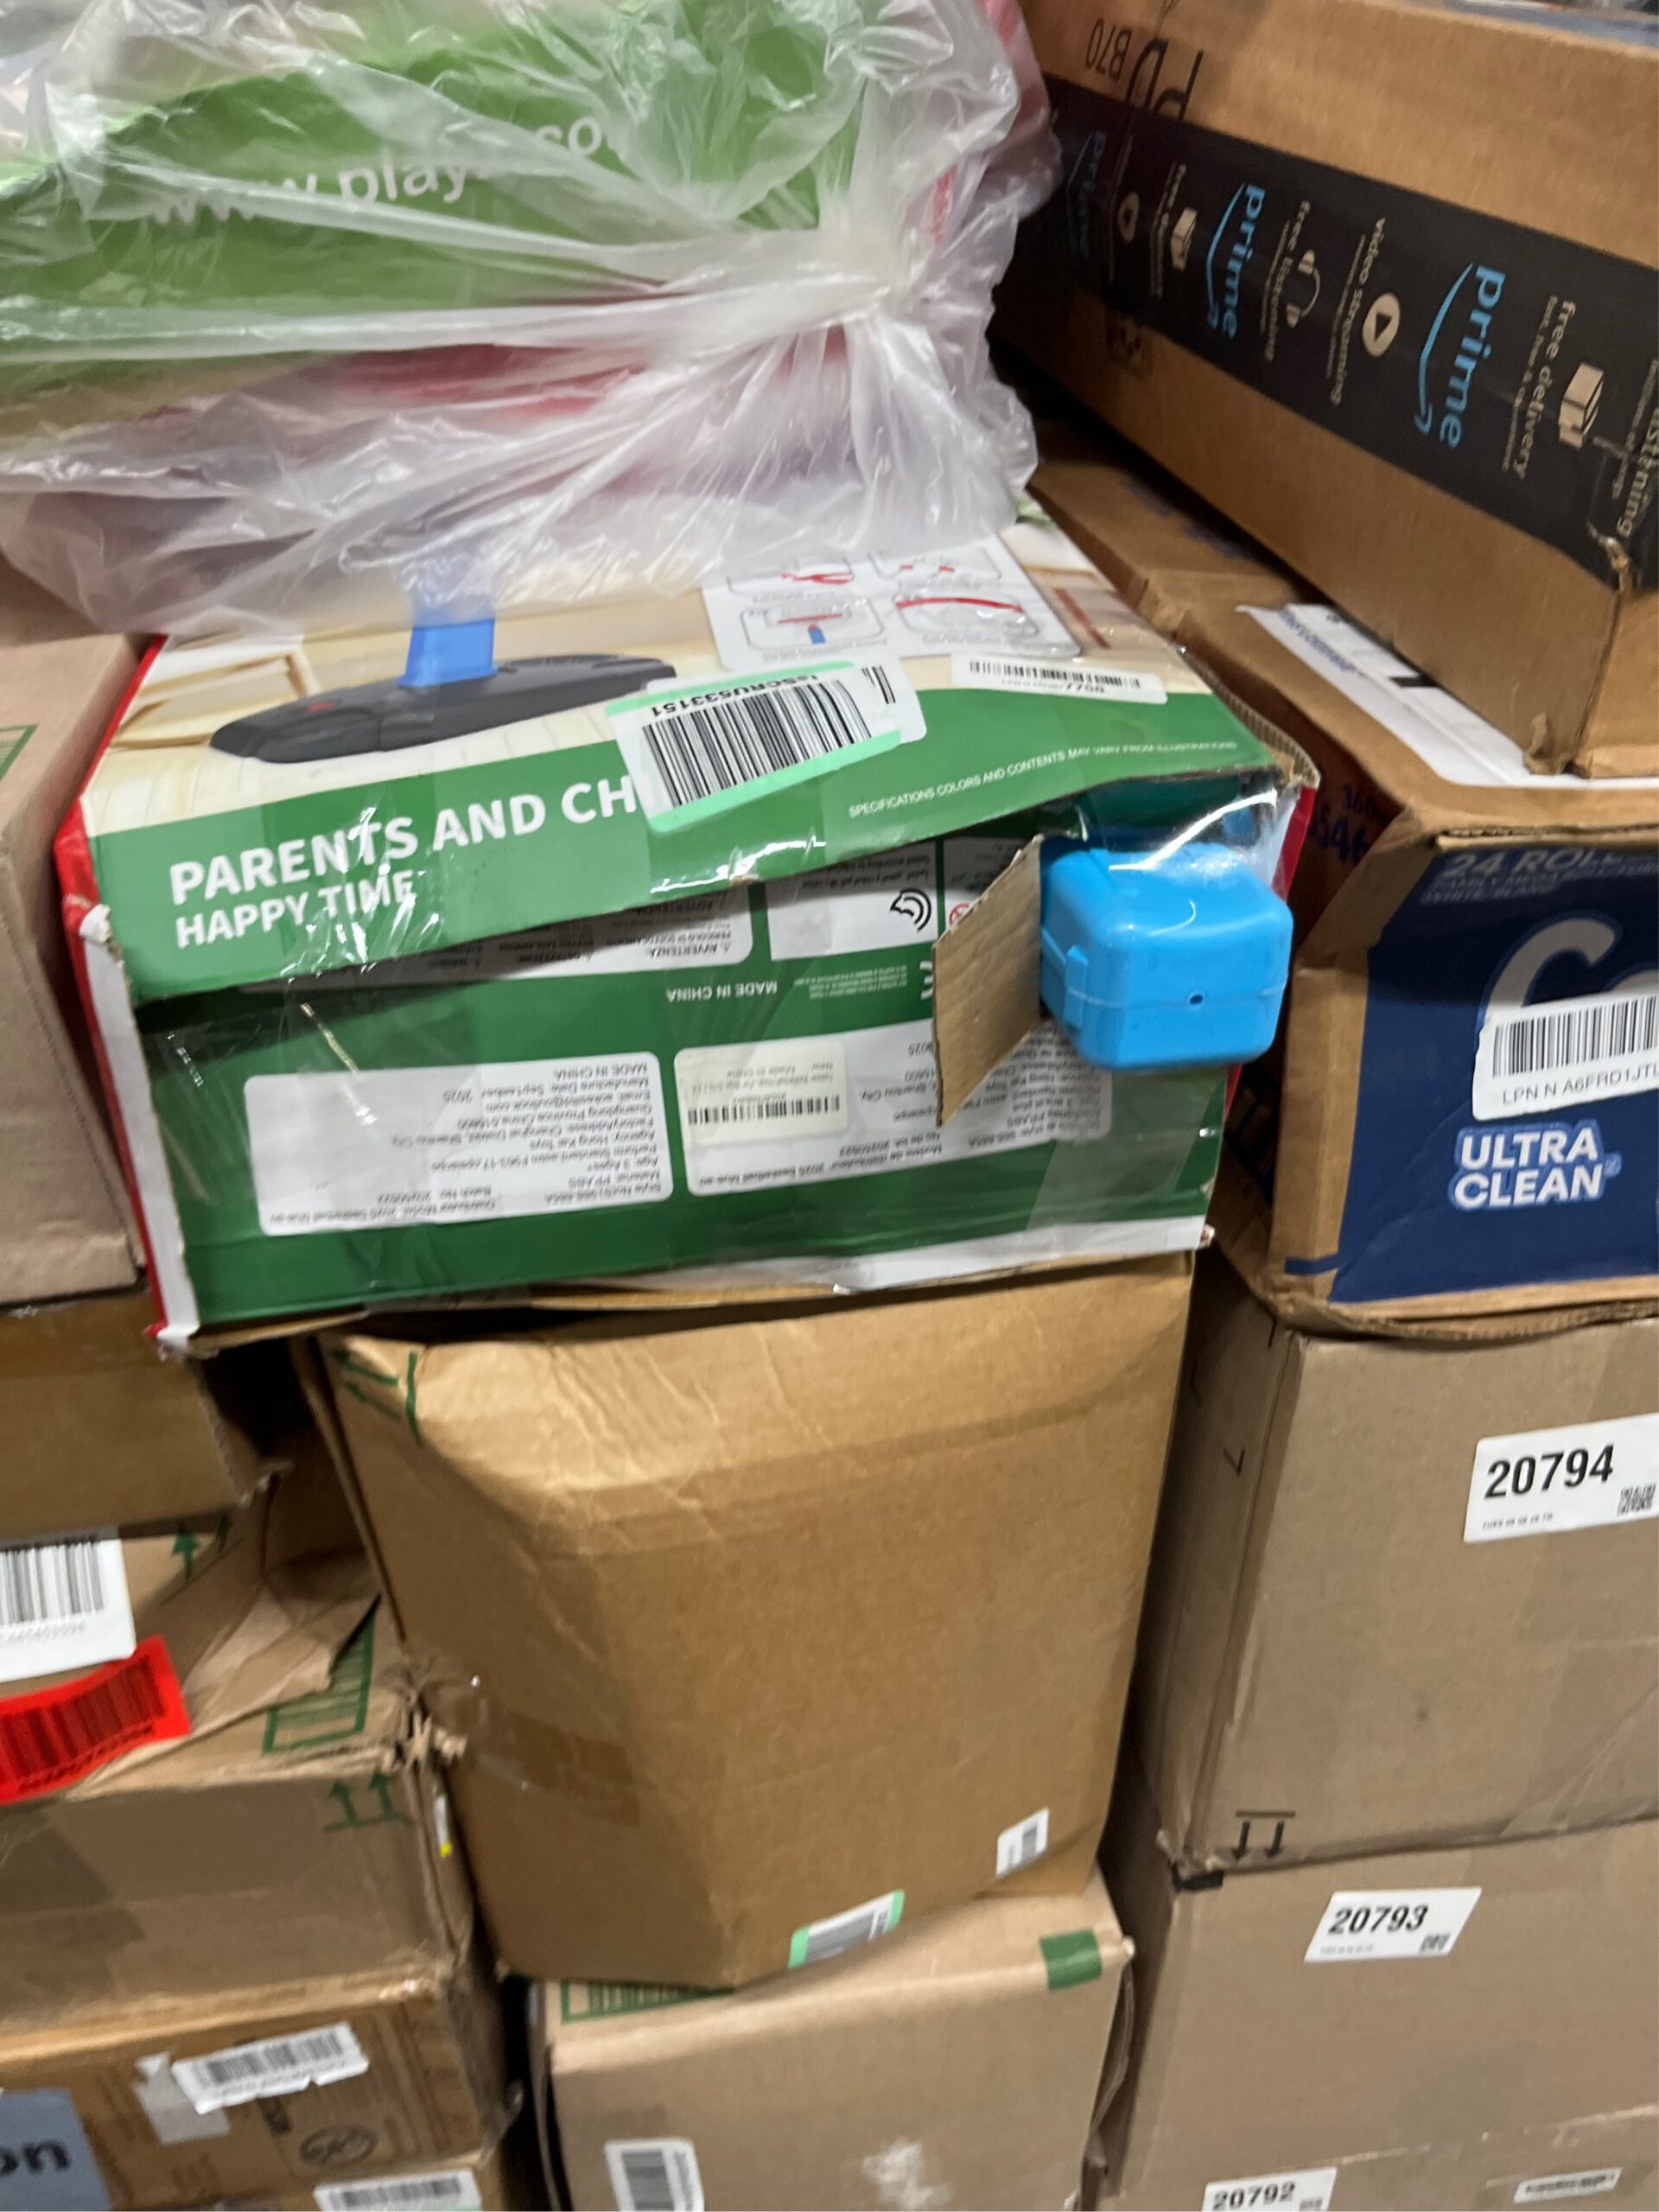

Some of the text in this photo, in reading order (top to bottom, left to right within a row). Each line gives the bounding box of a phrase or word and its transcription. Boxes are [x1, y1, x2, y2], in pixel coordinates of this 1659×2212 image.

[1222, 184, 1266, 339] prime
[1359, 218, 1386, 286] video
[1438, 265, 1507, 448] prime
[1514, 301, 1576, 480] free delivery
[848, 788, 936, 818] SPECIFICATIONS
[936, 775, 982, 798] COLORS
[982, 769, 1006, 785] AND
[1006, 751, 1066, 776] CONTENTS
[168, 817, 418, 906] PARENTS
[432, 793, 547, 853] AND
[1440, 852, 1505, 879] 24
[175, 868, 416, 950] HAPPY TIME
[664, 986, 712, 1002] CHINA
[715, 984, 730, 998] IN
[733, 980, 778, 997] MADE
[553, 1066, 594, 1081] CHINA
[611, 1061, 647, 1076] MADE
[1502, 1083, 1538, 1106] LPN
[1460, 1127, 1599, 1168] ULTRA
[797, 1161, 825, 1177] 2025
[1484, 1443, 1616, 1500] 20794
[1327, 1904, 1430, 1936] 20793
[1211, 2181, 1295, 2211] 20792
